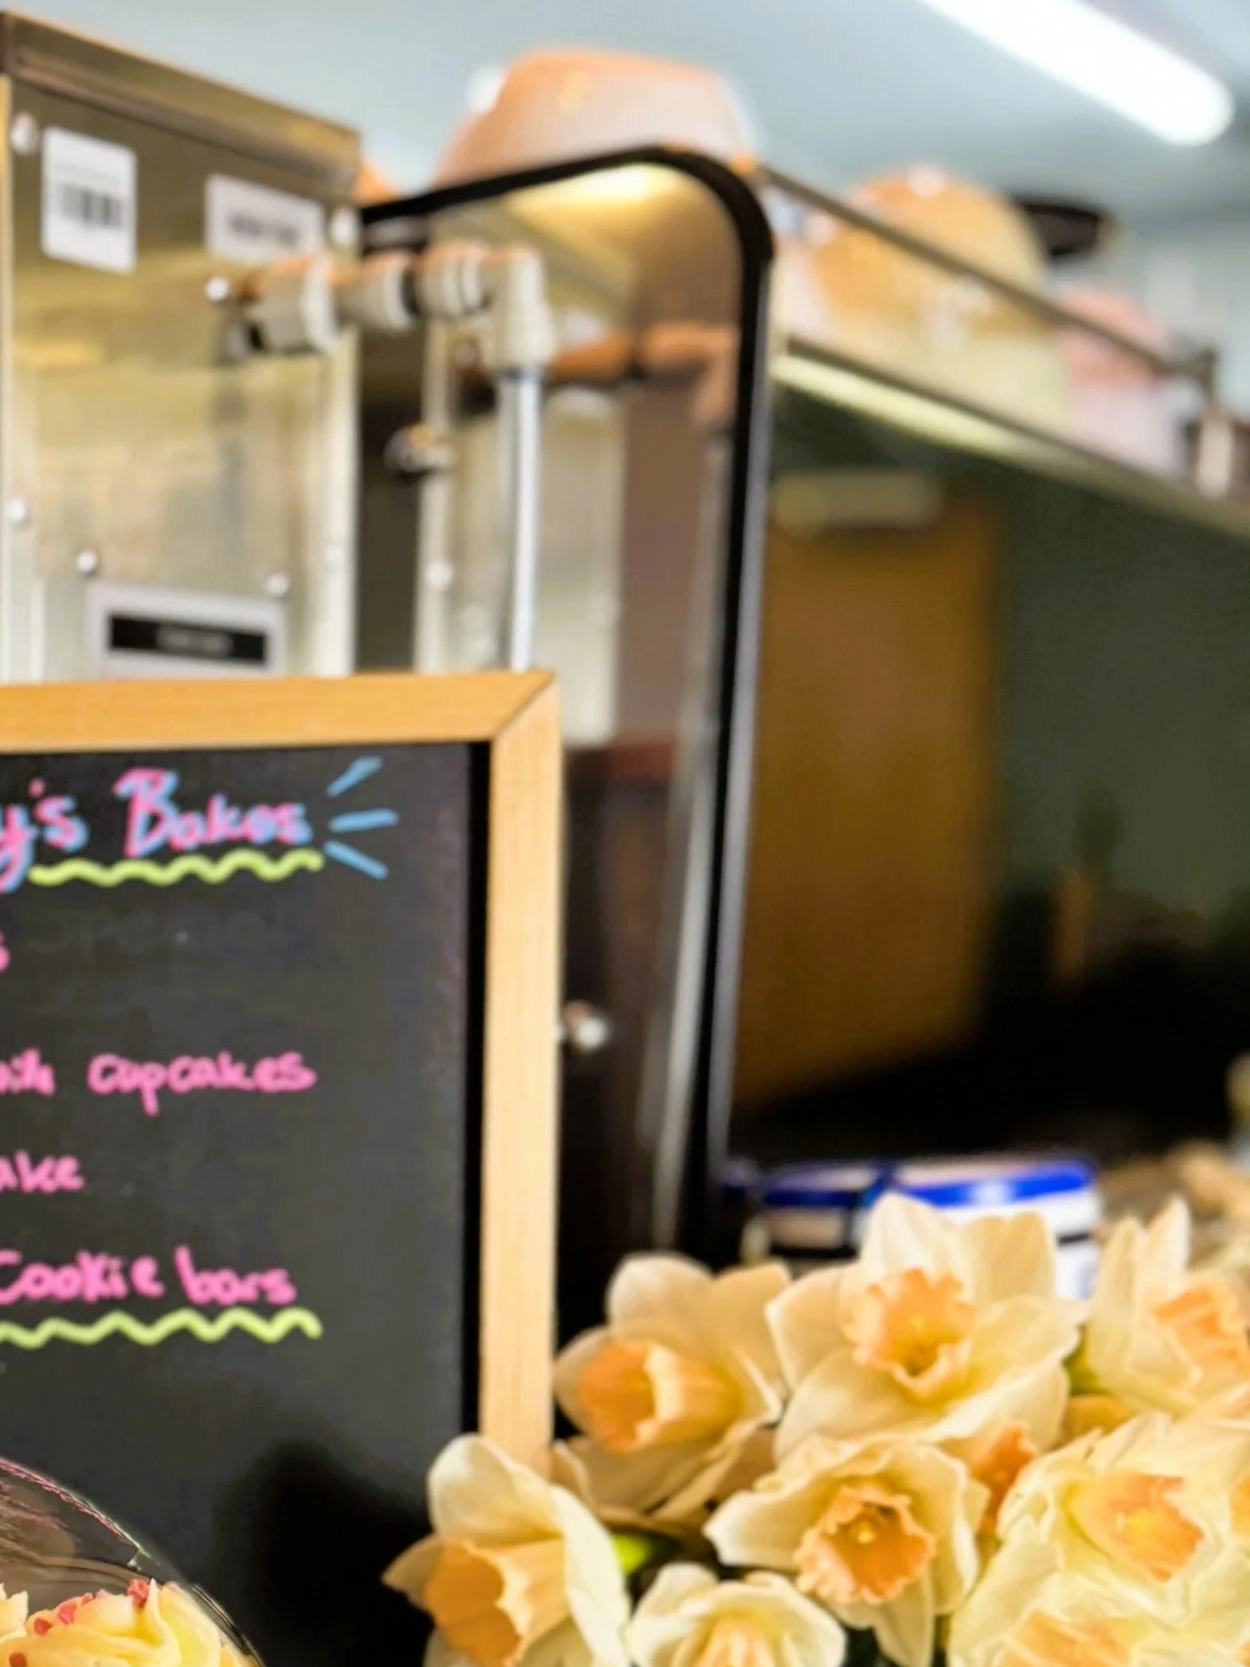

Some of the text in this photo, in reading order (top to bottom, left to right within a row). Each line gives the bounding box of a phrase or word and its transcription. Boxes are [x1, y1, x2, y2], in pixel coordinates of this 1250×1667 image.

[112, 767, 314, 858] Bakes
[87, 1050, 317, 1117] cupcakes
[174, 1243, 298, 1306] bars
